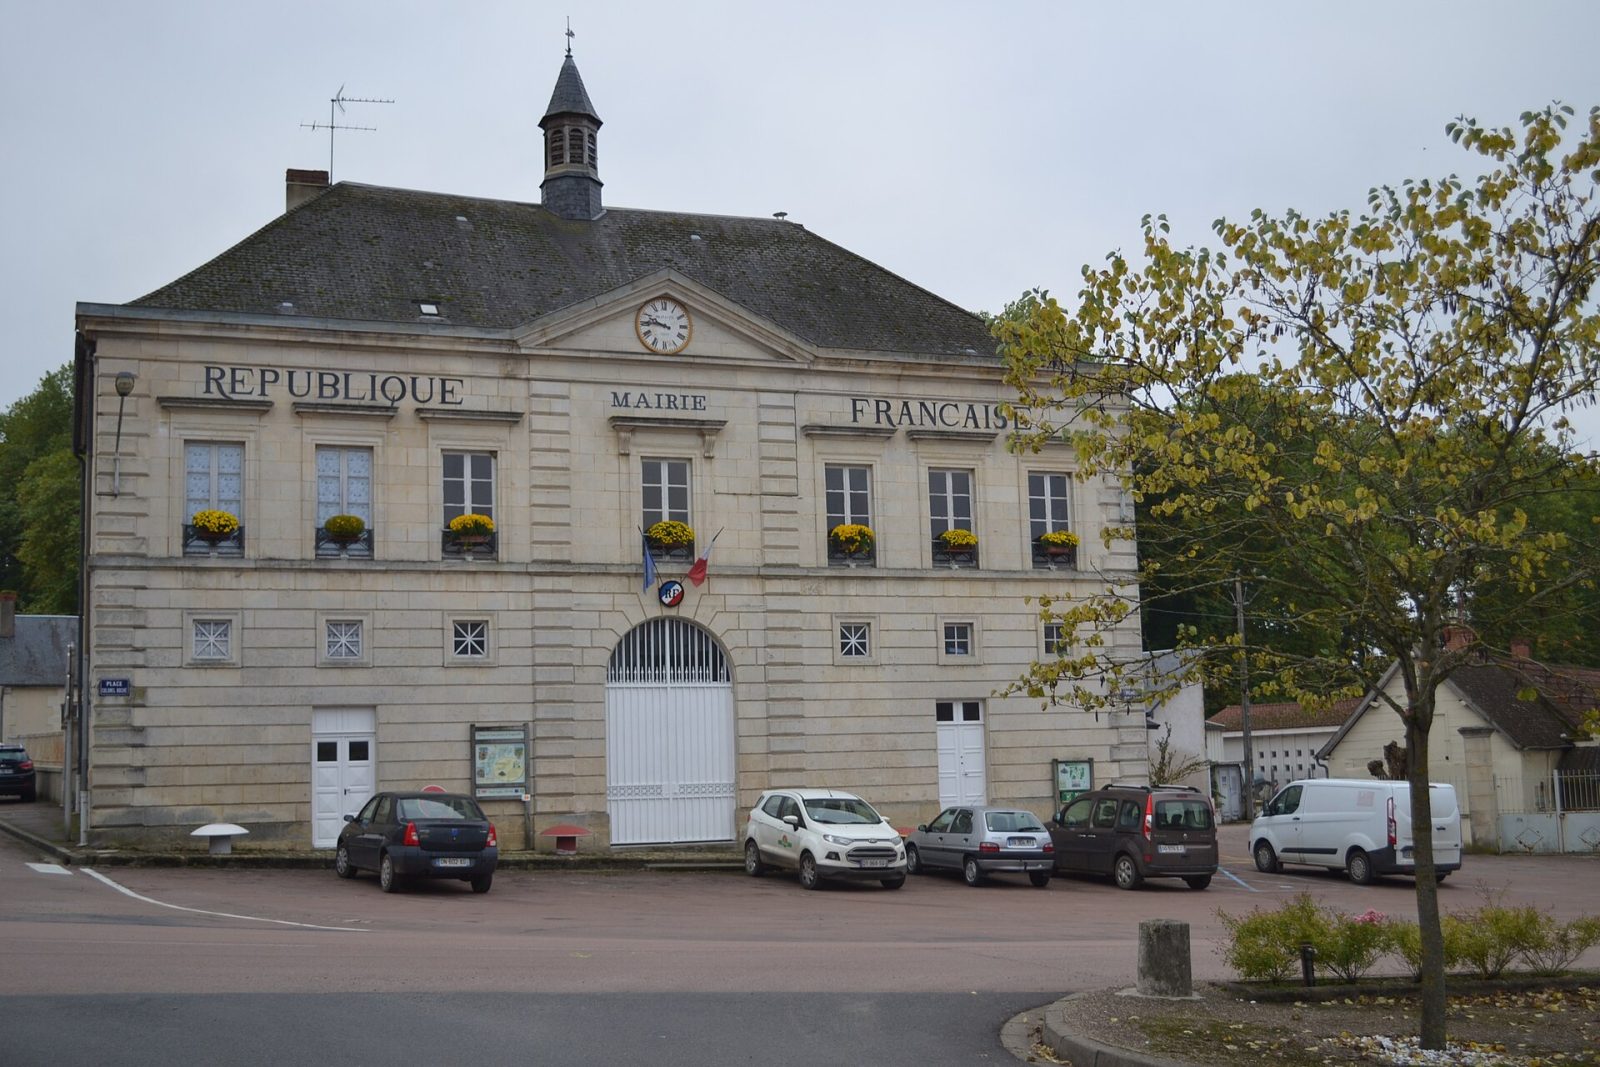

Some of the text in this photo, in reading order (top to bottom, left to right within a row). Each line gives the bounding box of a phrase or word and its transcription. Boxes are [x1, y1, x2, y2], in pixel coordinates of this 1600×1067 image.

[203, 365, 464, 407] REPUBLIQUE
[610, 391, 706, 411] MAIRIE
[850, 398, 1033, 431] FRANCAISE
[665, 589, 680, 598] RF
